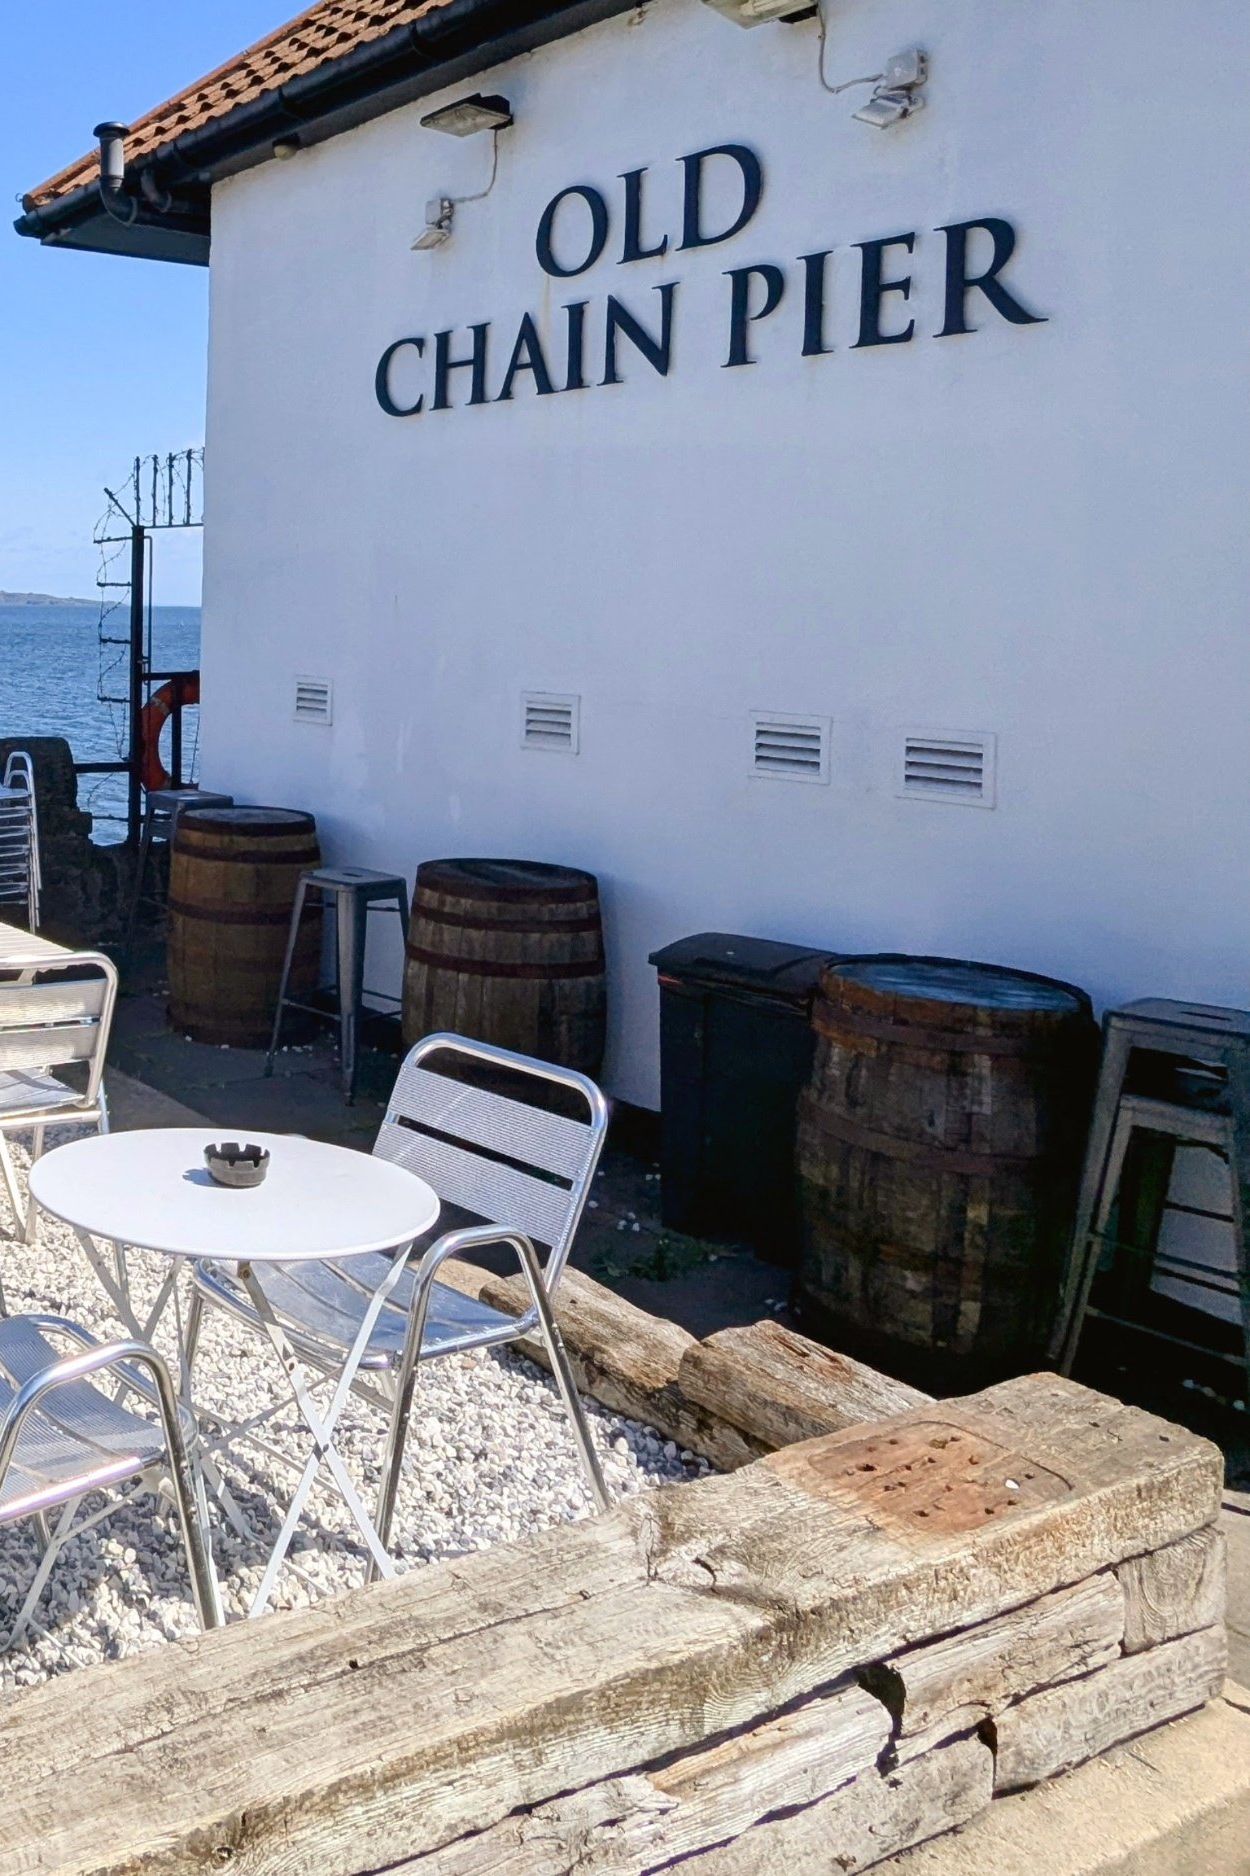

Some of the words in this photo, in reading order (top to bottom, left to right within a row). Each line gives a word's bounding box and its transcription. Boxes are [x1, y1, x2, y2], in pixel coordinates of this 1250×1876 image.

[535, 143, 765, 278] OLD
[374, 281, 681, 418] CHAIN
[720, 217, 1050, 368] PIER
